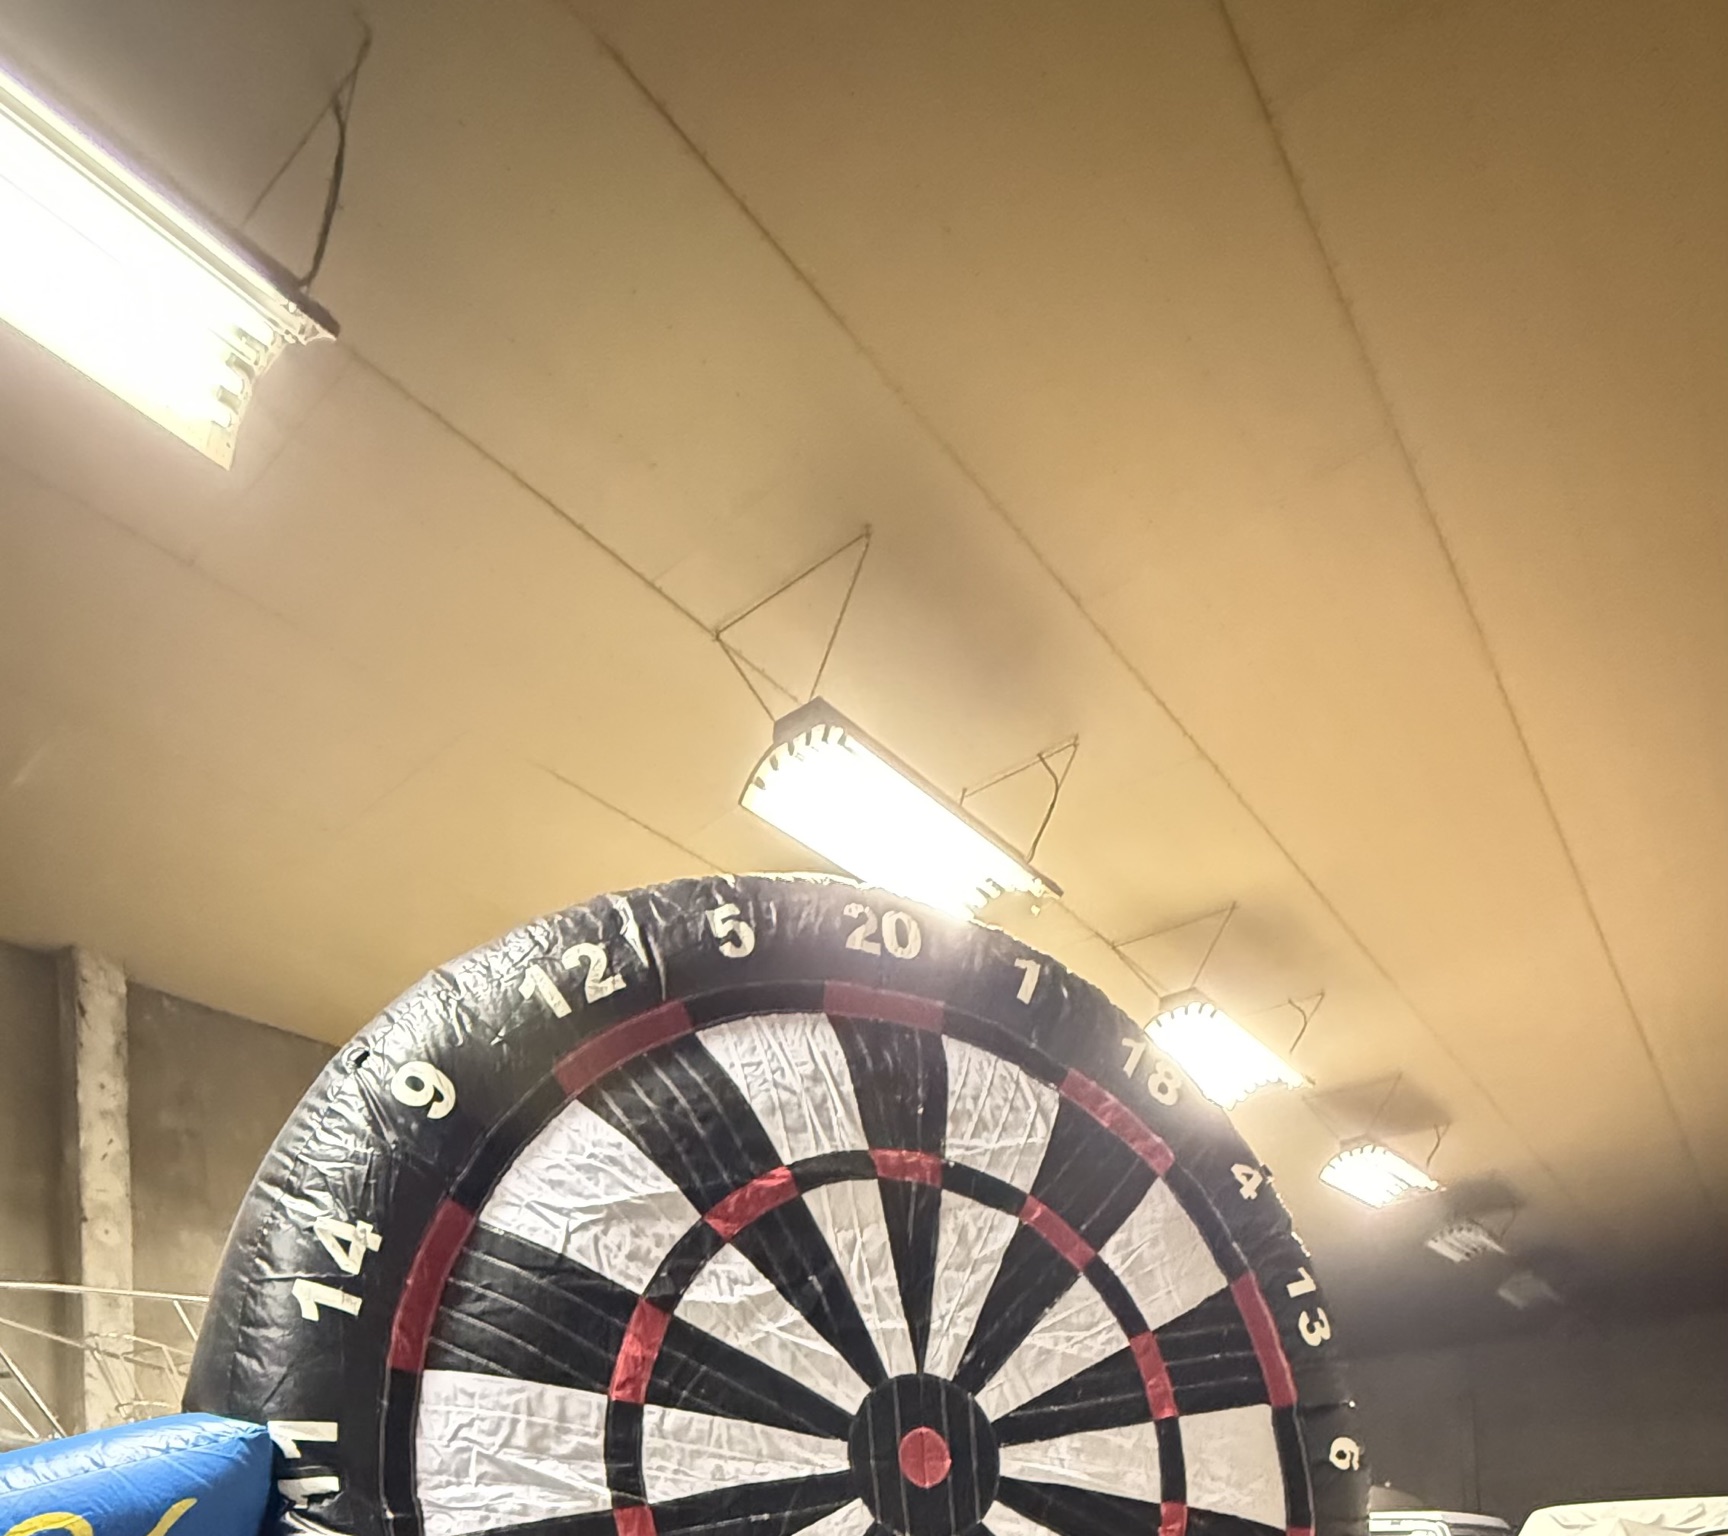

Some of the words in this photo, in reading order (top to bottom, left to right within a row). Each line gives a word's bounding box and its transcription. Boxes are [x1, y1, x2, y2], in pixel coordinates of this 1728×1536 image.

[706, 903, 756, 958] 5
[843, 903, 922, 960] 20
[519, 942, 627, 1018] 12
[1014, 957, 1042, 1005] 1
[390, 1061, 456, 1120] 9
[1121, 1037, 1182, 1106] 18
[1231, 1162, 1264, 1200] 4
[292, 1217, 383, 1322] 14
[1286, 1267, 1331, 1347] 13
[1329, 1437, 1360, 1471] 6
